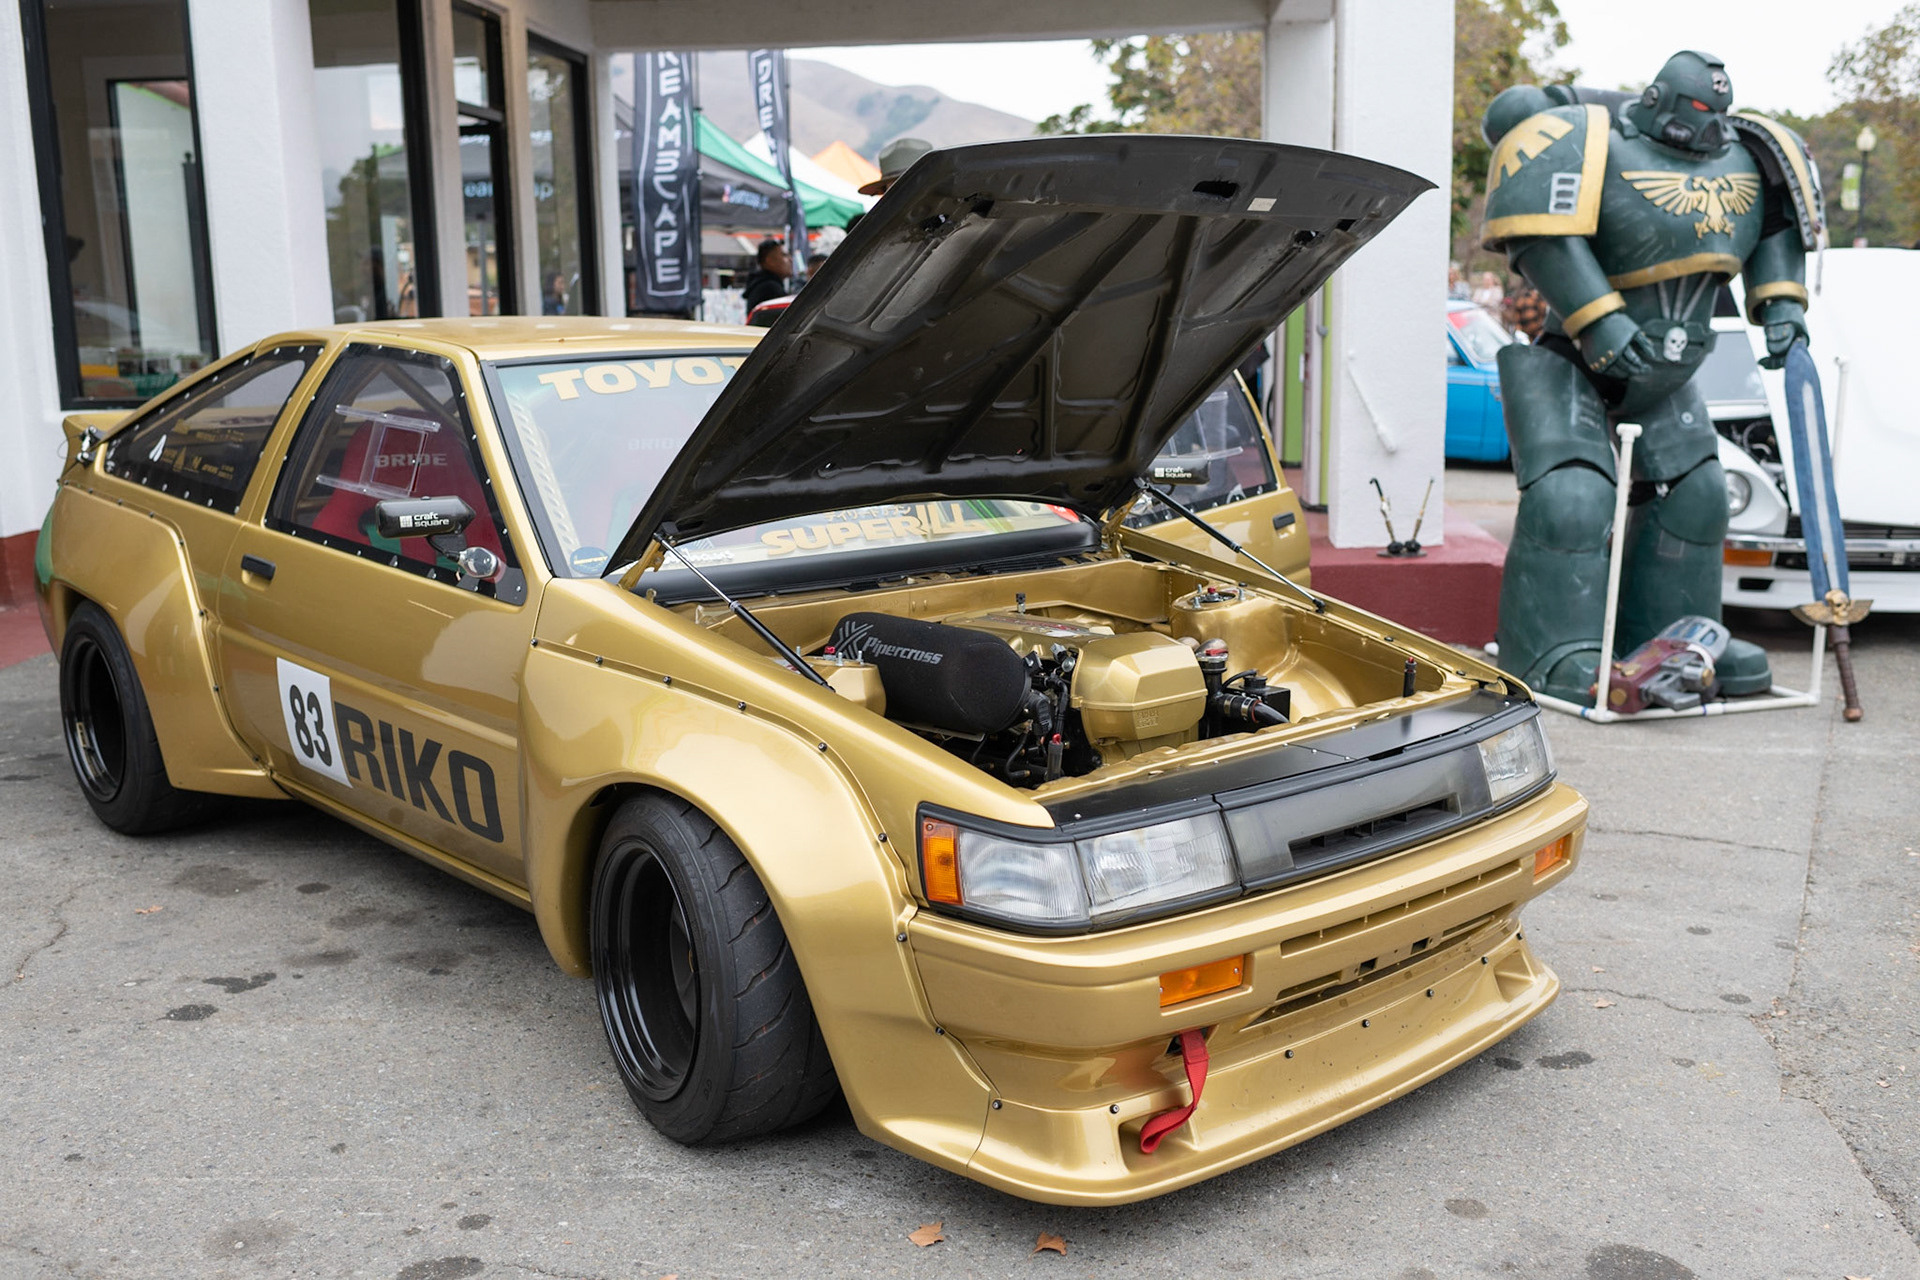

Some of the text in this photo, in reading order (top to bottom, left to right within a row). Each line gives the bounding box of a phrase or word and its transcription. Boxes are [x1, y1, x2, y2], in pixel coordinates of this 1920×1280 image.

[375, 453, 449, 468] BRIDE
[413, 511, 439, 520] craft
[414, 518, 450, 528] square
[863, 636, 944, 665] Pipercross
[289, 684, 504, 843] 83 RIKO
